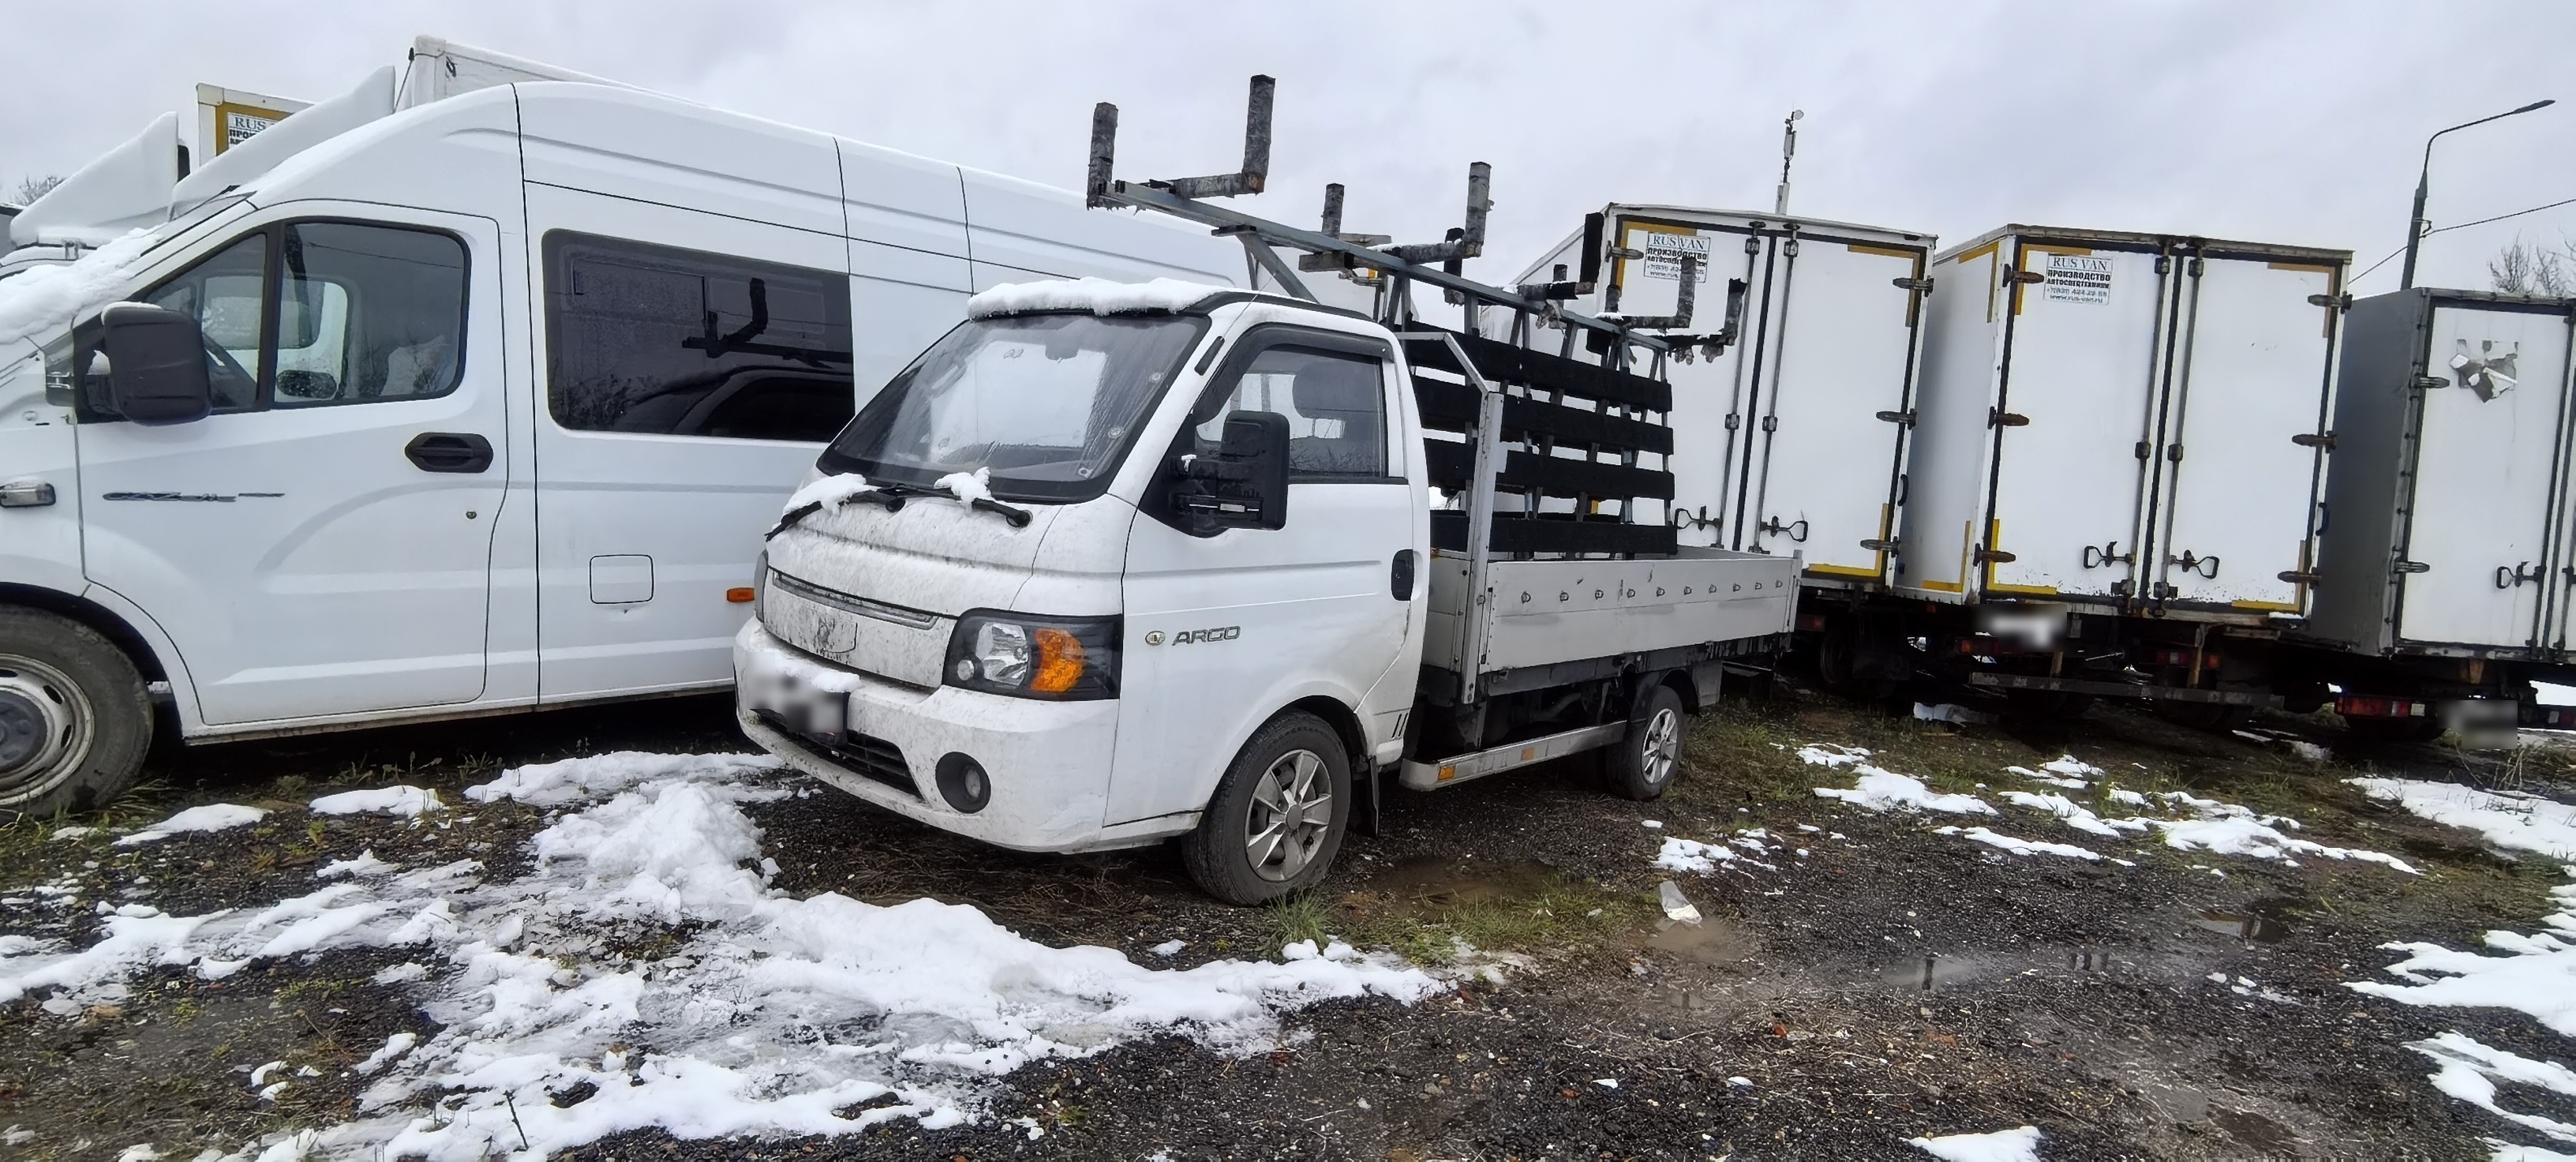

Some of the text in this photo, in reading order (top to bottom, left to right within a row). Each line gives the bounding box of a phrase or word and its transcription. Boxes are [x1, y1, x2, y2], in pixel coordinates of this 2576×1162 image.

[235, 117, 267, 131] RUS
[1653, 235, 1705, 249] RUS VAN
[2053, 257, 2107, 271] RUS VAN
[2047, 269, 2110, 281] ПРОИЗВОДСТВО
[1172, 626, 1241, 646] ARGO
